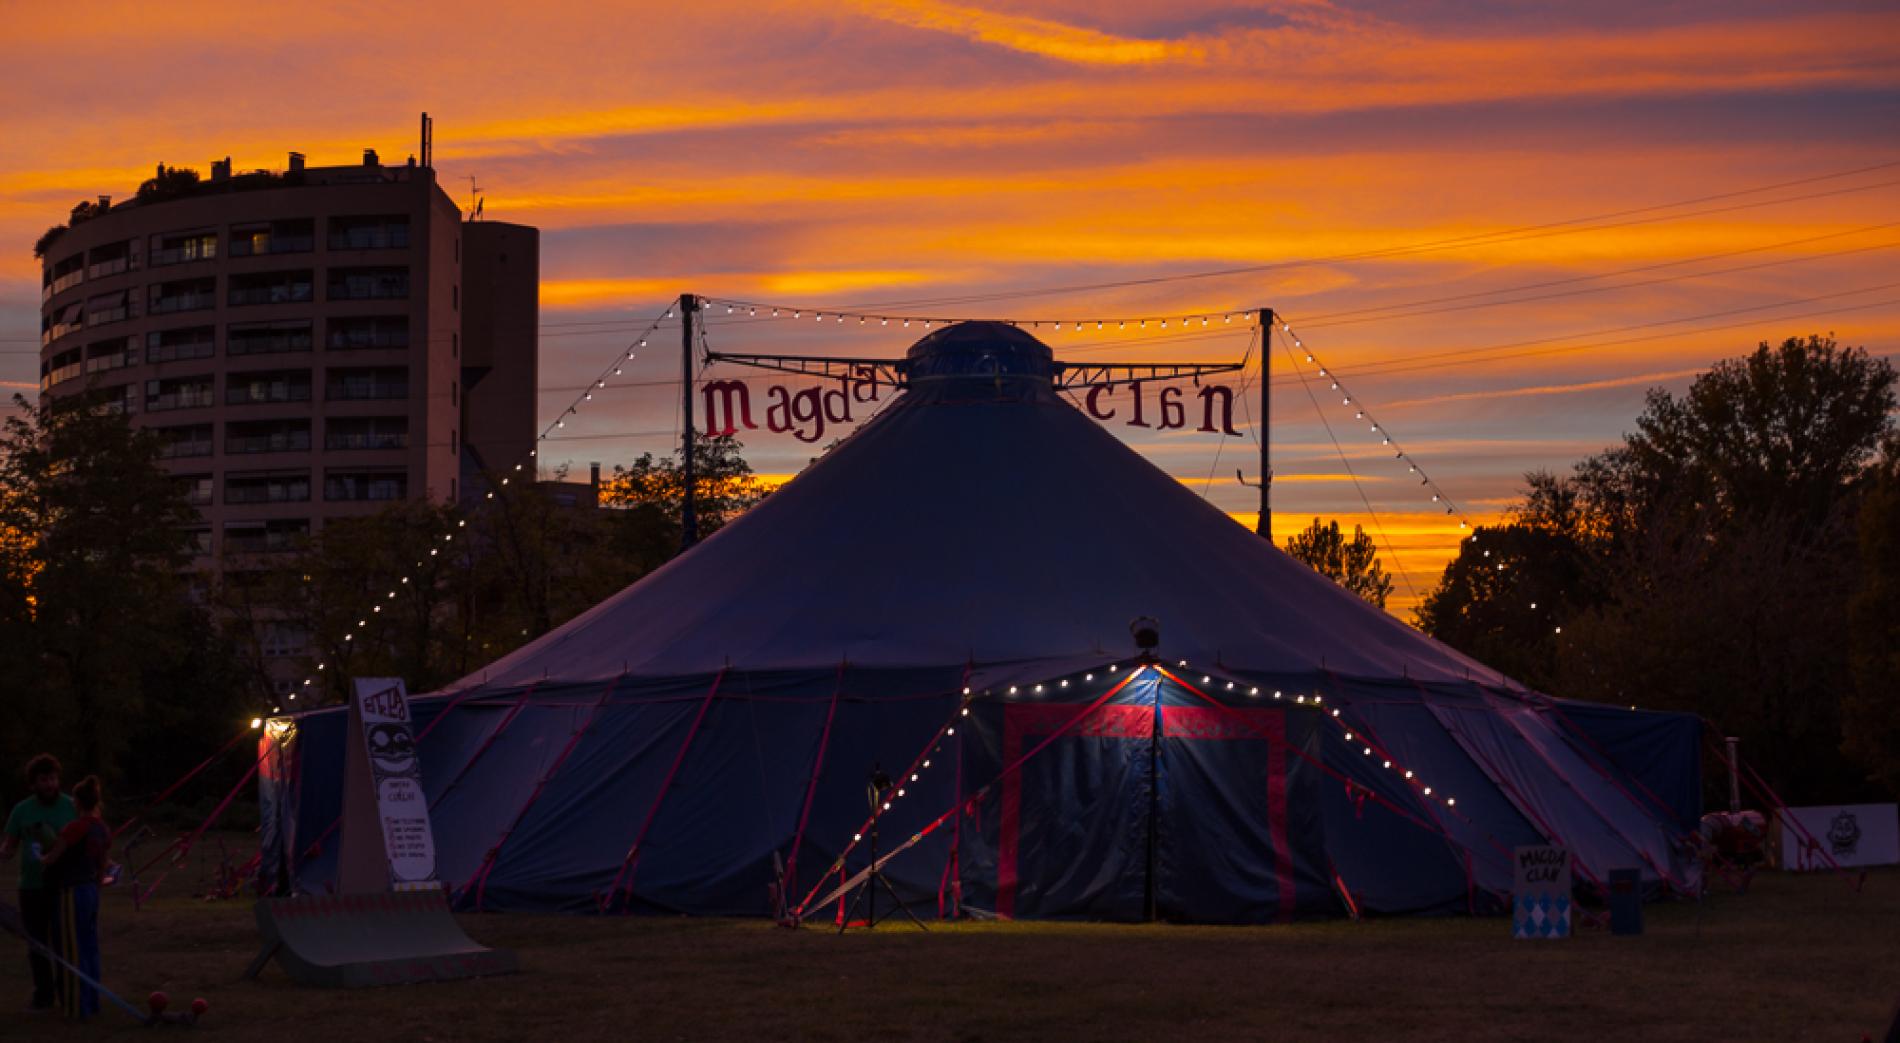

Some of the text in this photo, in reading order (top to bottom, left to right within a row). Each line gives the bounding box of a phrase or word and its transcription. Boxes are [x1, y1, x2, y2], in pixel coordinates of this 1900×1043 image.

[701, 367, 1243, 443] magda clan
[1519, 848, 1566, 867] MAGDA
[1526, 867, 1559, 883] CLAN
